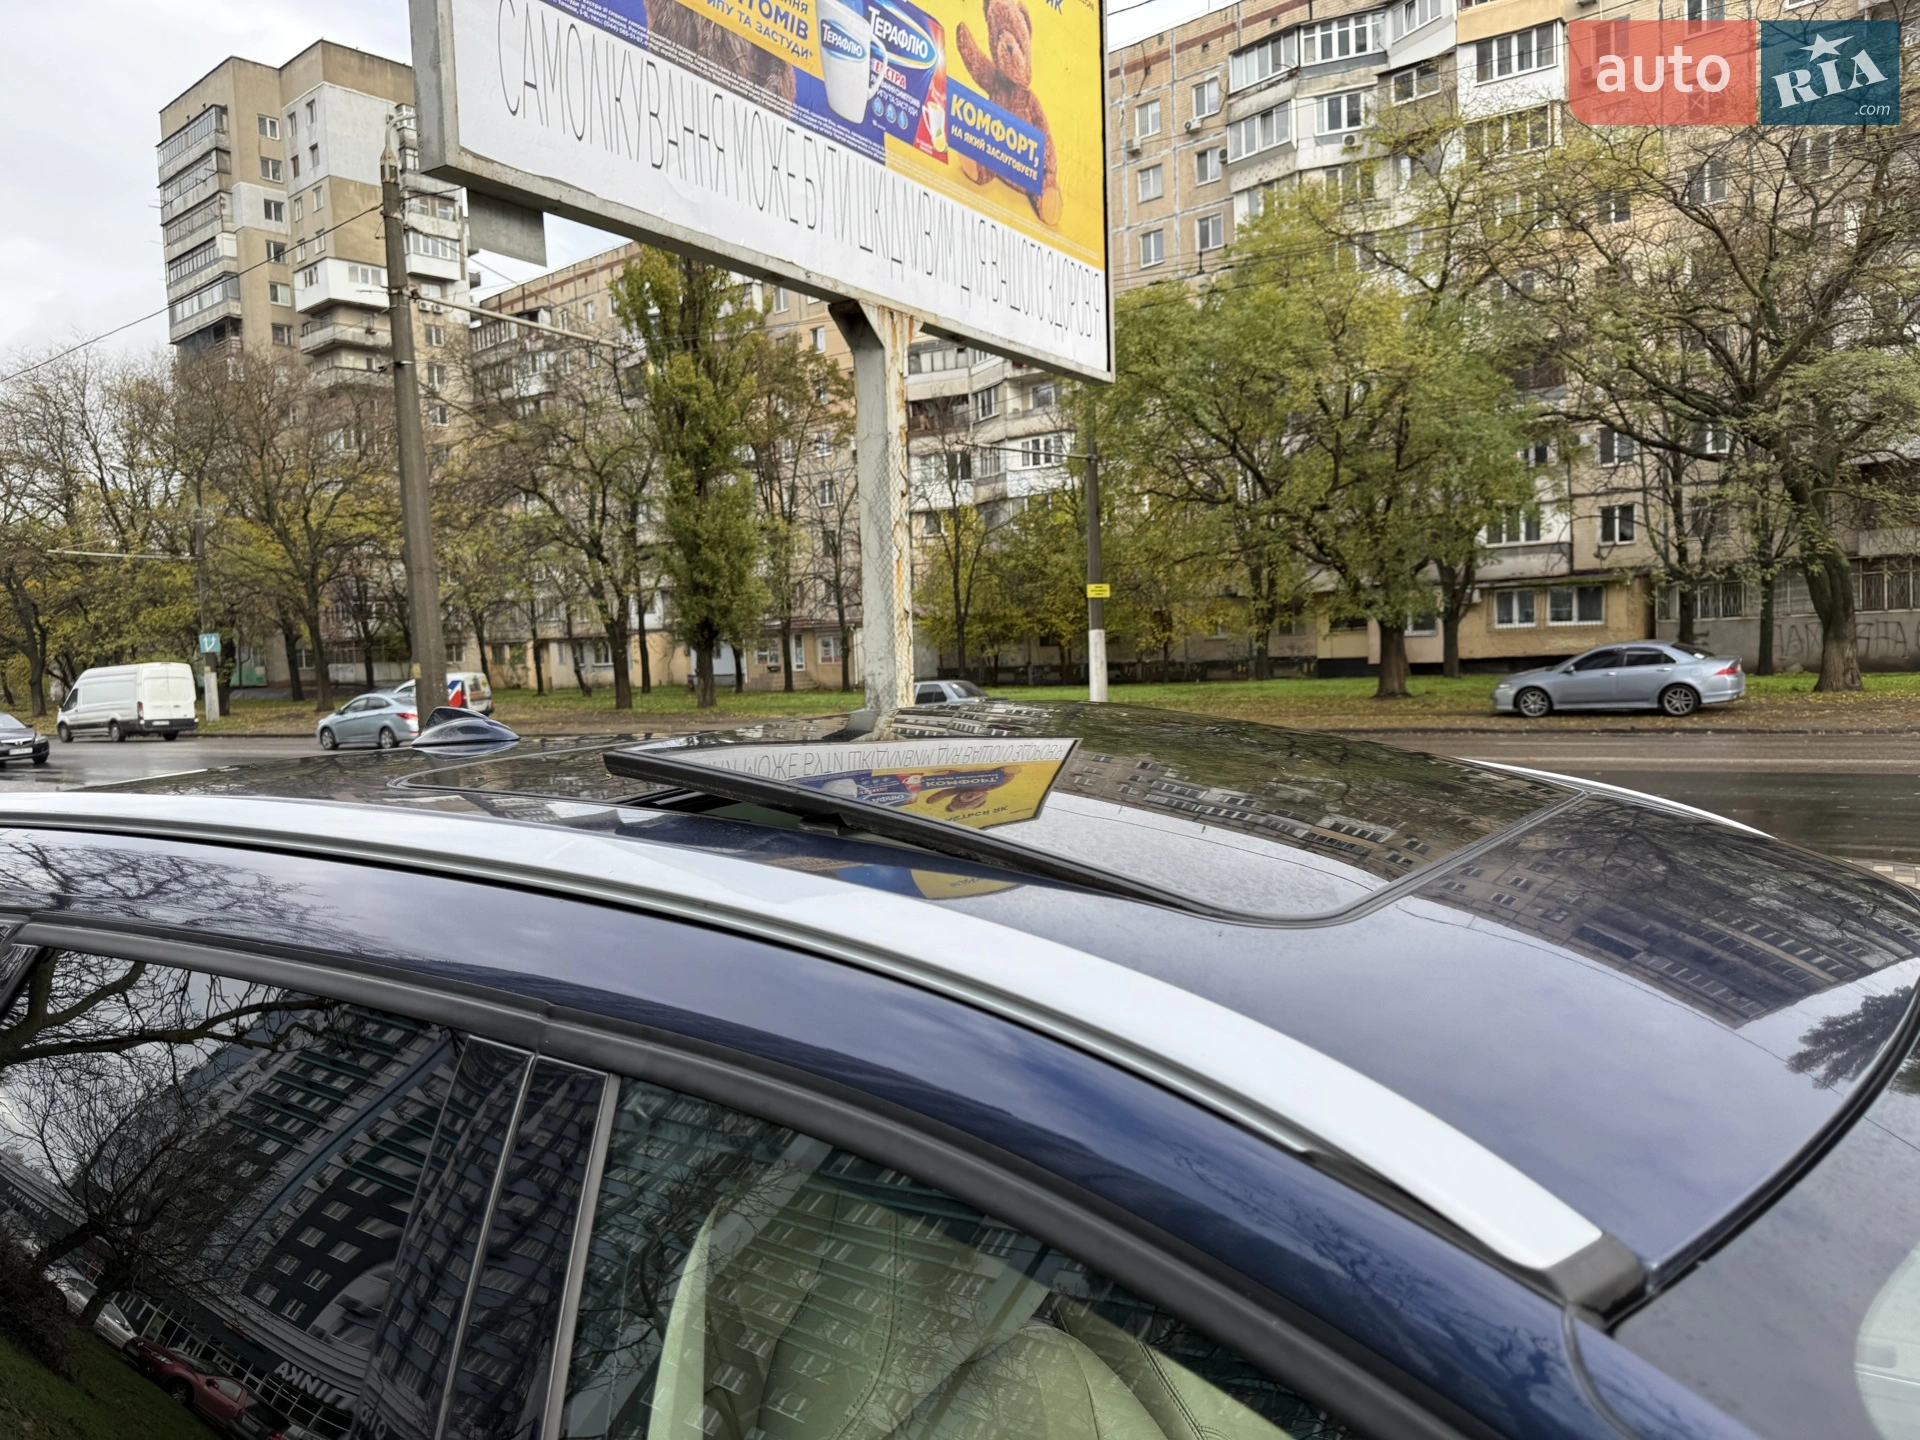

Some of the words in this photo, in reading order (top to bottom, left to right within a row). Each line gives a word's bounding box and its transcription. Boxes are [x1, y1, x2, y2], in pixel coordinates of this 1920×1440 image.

[738, 10, 752, 28] ТА
[738, 0, 809, 40] ОМІВ
[874, 60, 907, 89] ЕСТРА
[951, 94, 1039, 168] КОМФОРТ,
[951, 125, 963, 139] НА
[963, 131, 985, 152] ЯКИЙ
[733, 100, 799, 225] МОЖЕ
[804, 134, 852, 246] БУТИ
[856, 158, 956, 286] ШКІДЛИВИМ
[960, 208, 988, 309] ДЛЯ
[991, 224, 1045, 322] ВАШОГО
